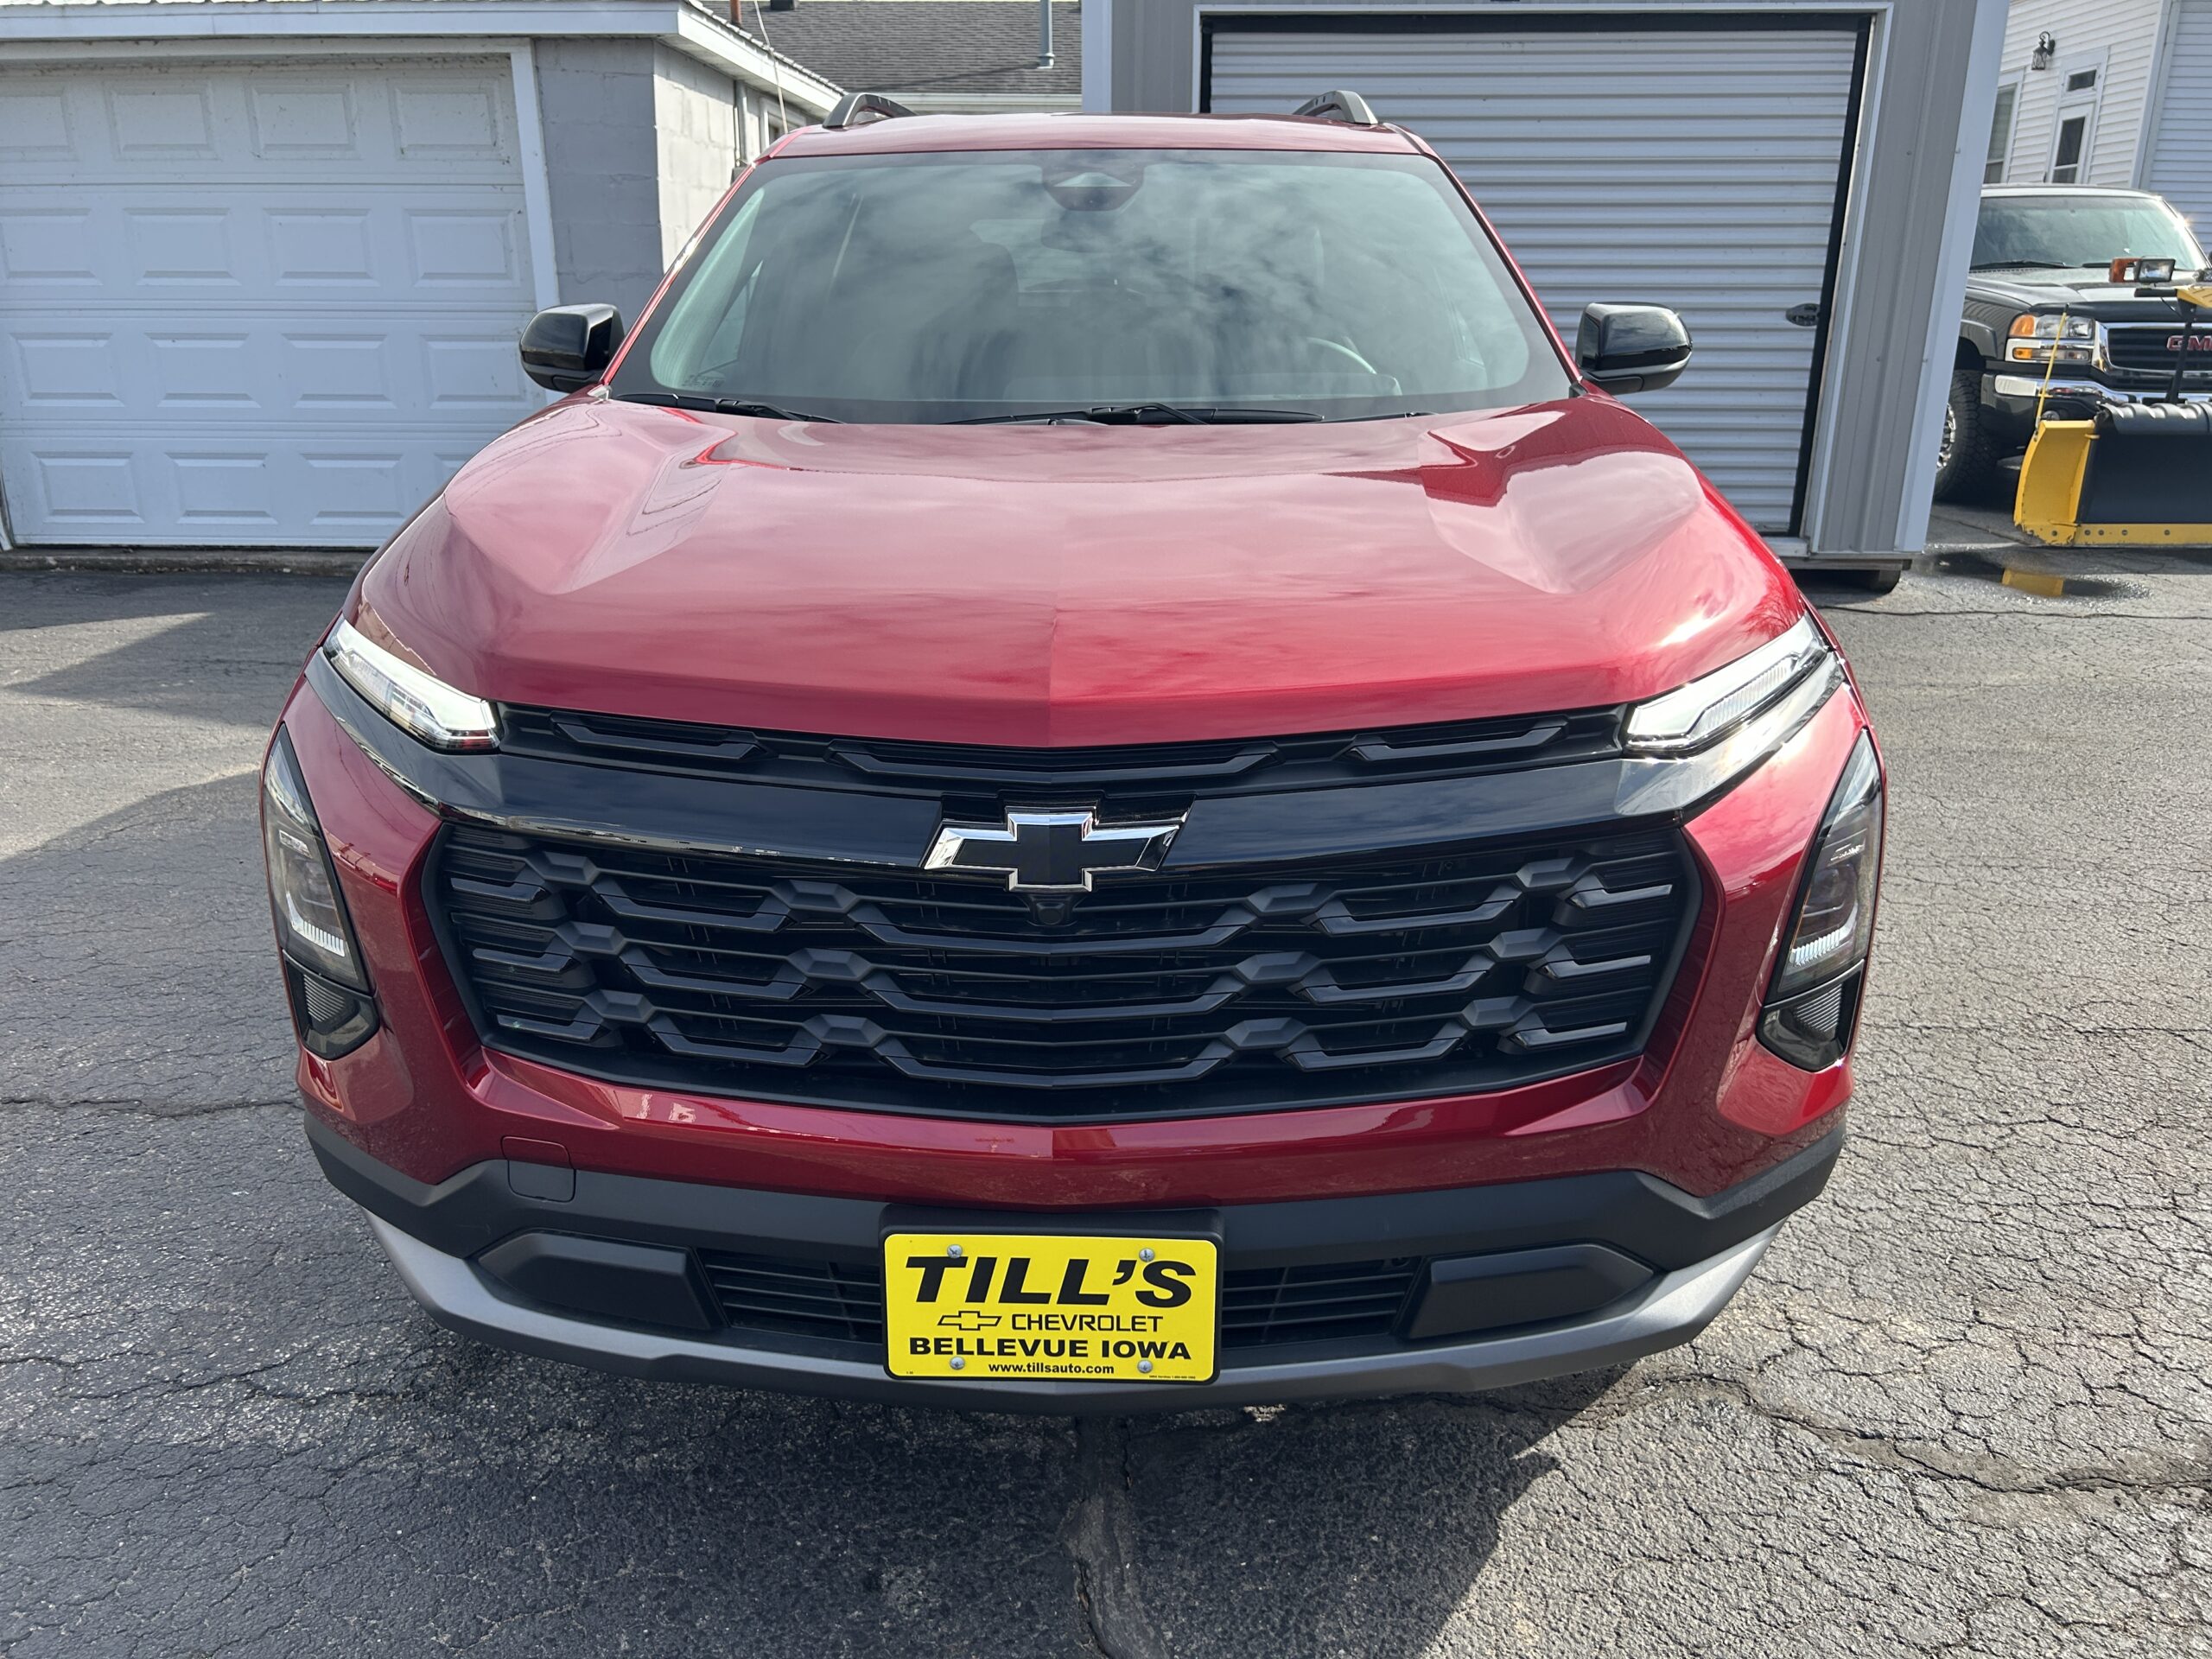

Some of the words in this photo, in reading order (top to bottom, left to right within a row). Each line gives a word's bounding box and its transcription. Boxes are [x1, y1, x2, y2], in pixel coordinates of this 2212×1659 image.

[906, 1256, 1197, 1307] TILL'S
[1011, 1313, 1163, 1332] CHEVROLET
[909, 1337, 1089, 1357] BELLEVUE
[1102, 1340, 1192, 1359] IOWA
[988, 1361, 1115, 1374] www.tillsauto.com
